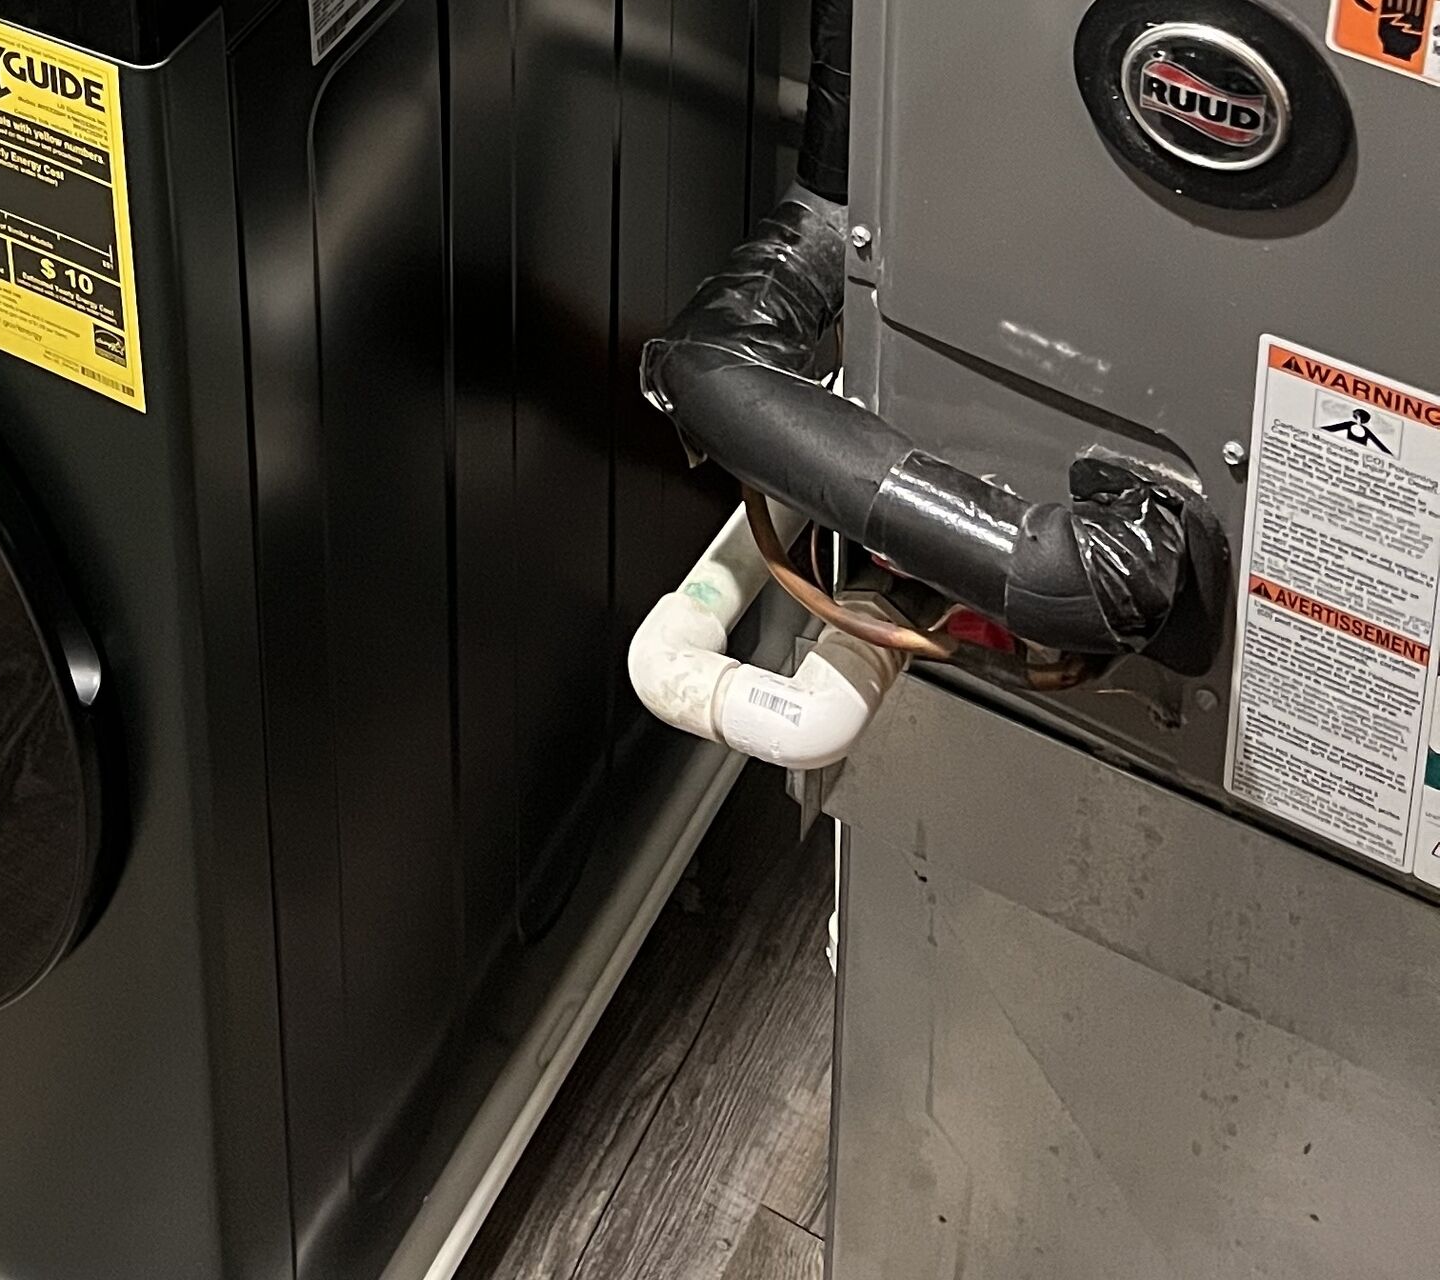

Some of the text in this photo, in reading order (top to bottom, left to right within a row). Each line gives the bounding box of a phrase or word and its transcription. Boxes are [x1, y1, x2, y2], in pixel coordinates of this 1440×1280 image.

[1146, 77, 1261, 130] RUUD
[63, 265, 94, 297] 10
[1305, 360, 1440, 426] WARNING
[1275, 592, 1430, 663] AVERTISSEMENT
